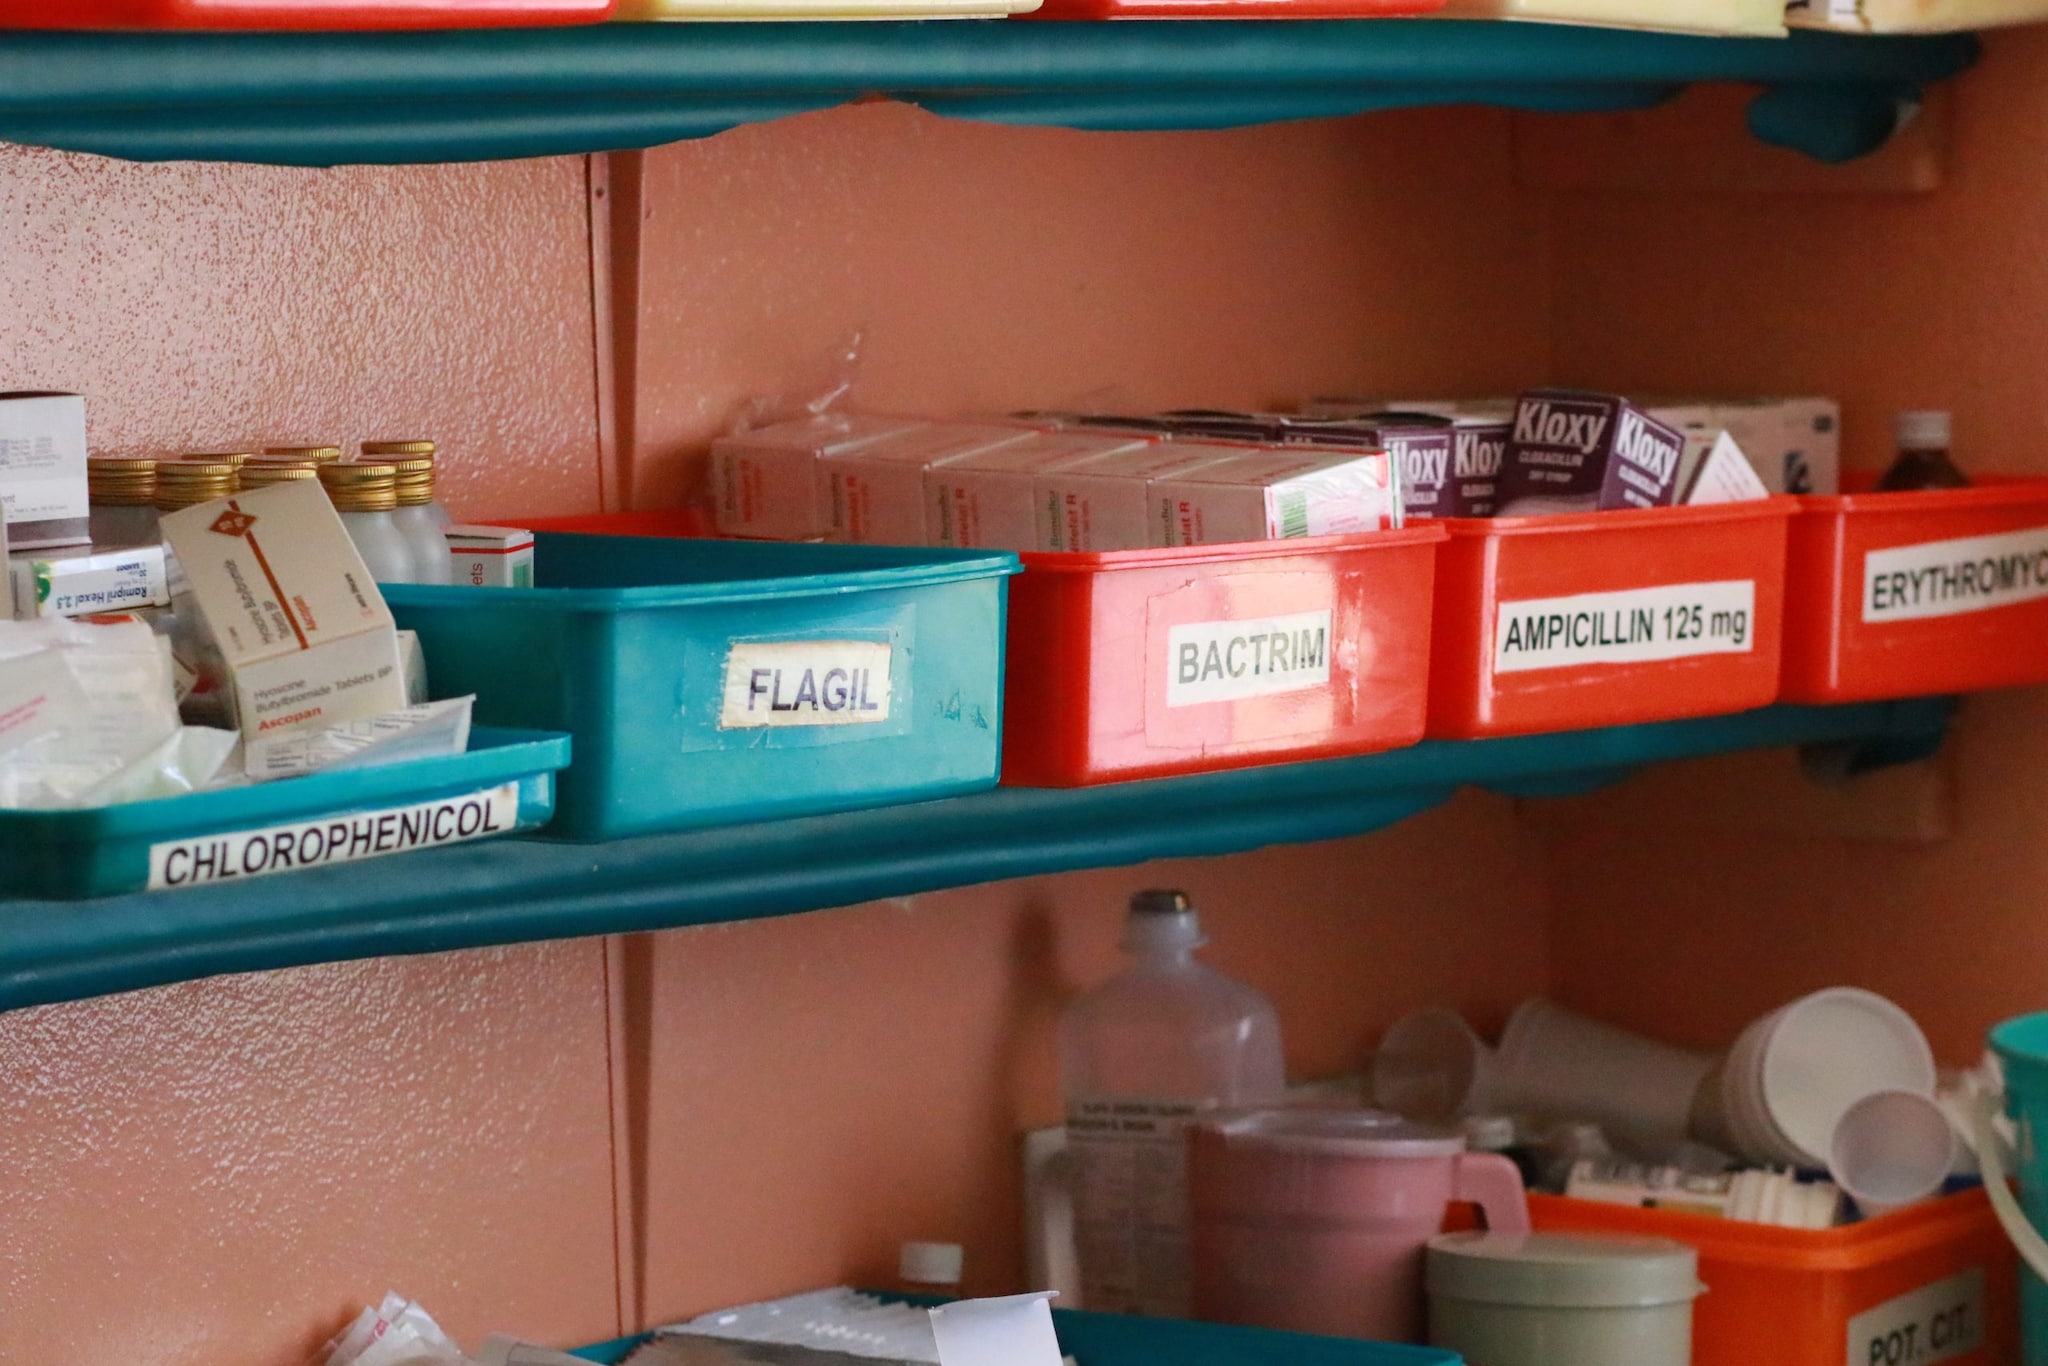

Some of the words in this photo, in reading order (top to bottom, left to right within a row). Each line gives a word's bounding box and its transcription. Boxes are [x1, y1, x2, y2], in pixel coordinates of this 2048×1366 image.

[1513, 401, 1607, 455] Kloxy
[1454, 433, 1505, 478] Klox
[1616, 411, 1678, 487] Kloxy
[1066, 494, 1077, 505] R
[1179, 502, 1190, 513] R
[75, 592, 105, 606] Hexal
[107, 587, 147, 604] Ramipril
[1504, 608, 1654, 652] AMPICILLIN
[1663, 605, 1704, 641] 125
[1710, 609, 1747, 644] mg
[1178, 627, 1325, 684] BACTRIM
[253, 679, 306, 700] Hyoscine
[336, 672, 375, 691] Tablets
[747, 667, 879, 712] FLAGIL
[258, 705, 322, 731] Ascopan
[164, 798, 499, 885] CHLOROPHENICOL
